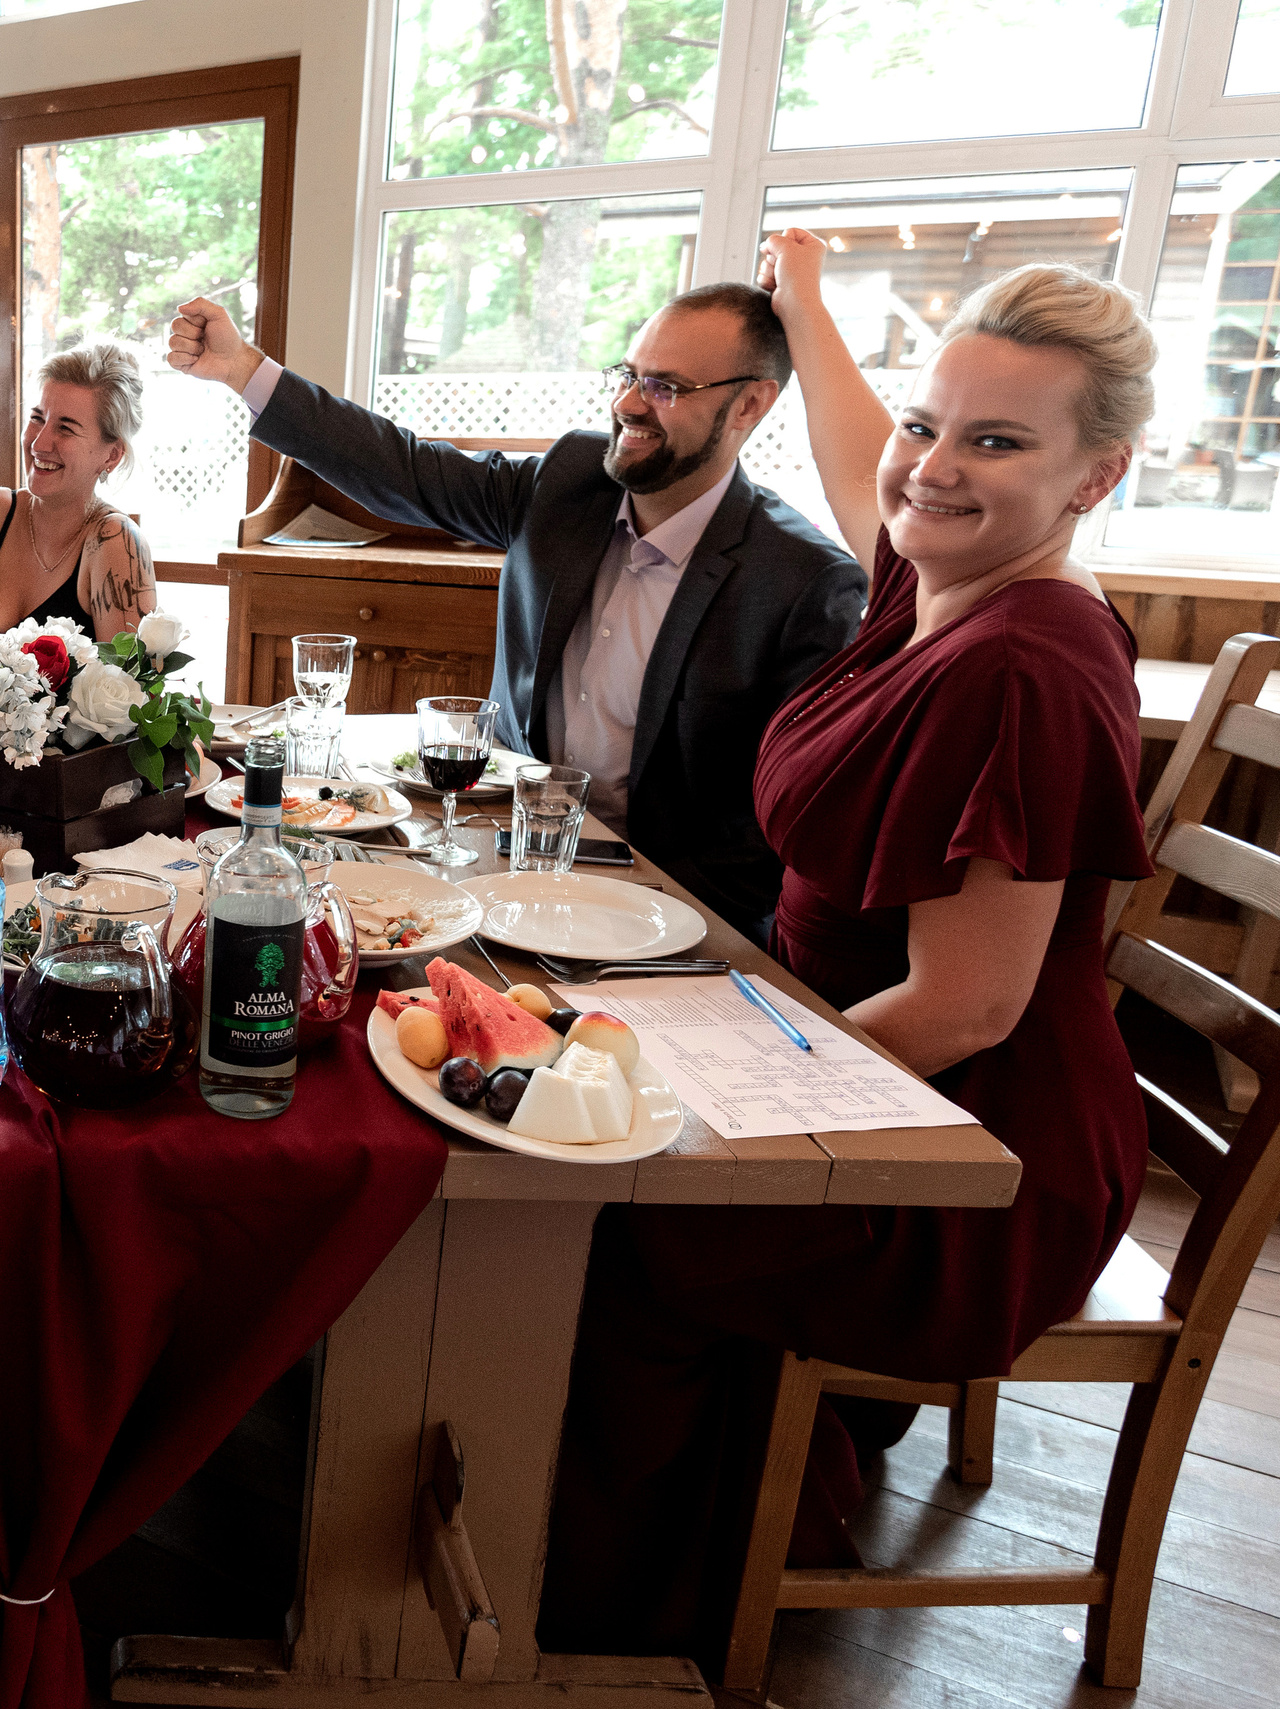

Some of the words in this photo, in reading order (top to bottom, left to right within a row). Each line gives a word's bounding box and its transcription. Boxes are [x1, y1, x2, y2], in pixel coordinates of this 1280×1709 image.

[248, 991, 286, 1003] ALMA
[234, 999, 294, 1017] ROMANA
[231, 1030, 261, 1040] PINOT
[264, 1027, 294, 1040] GRIGIO
[229, 1038, 259, 1048] DELLE
